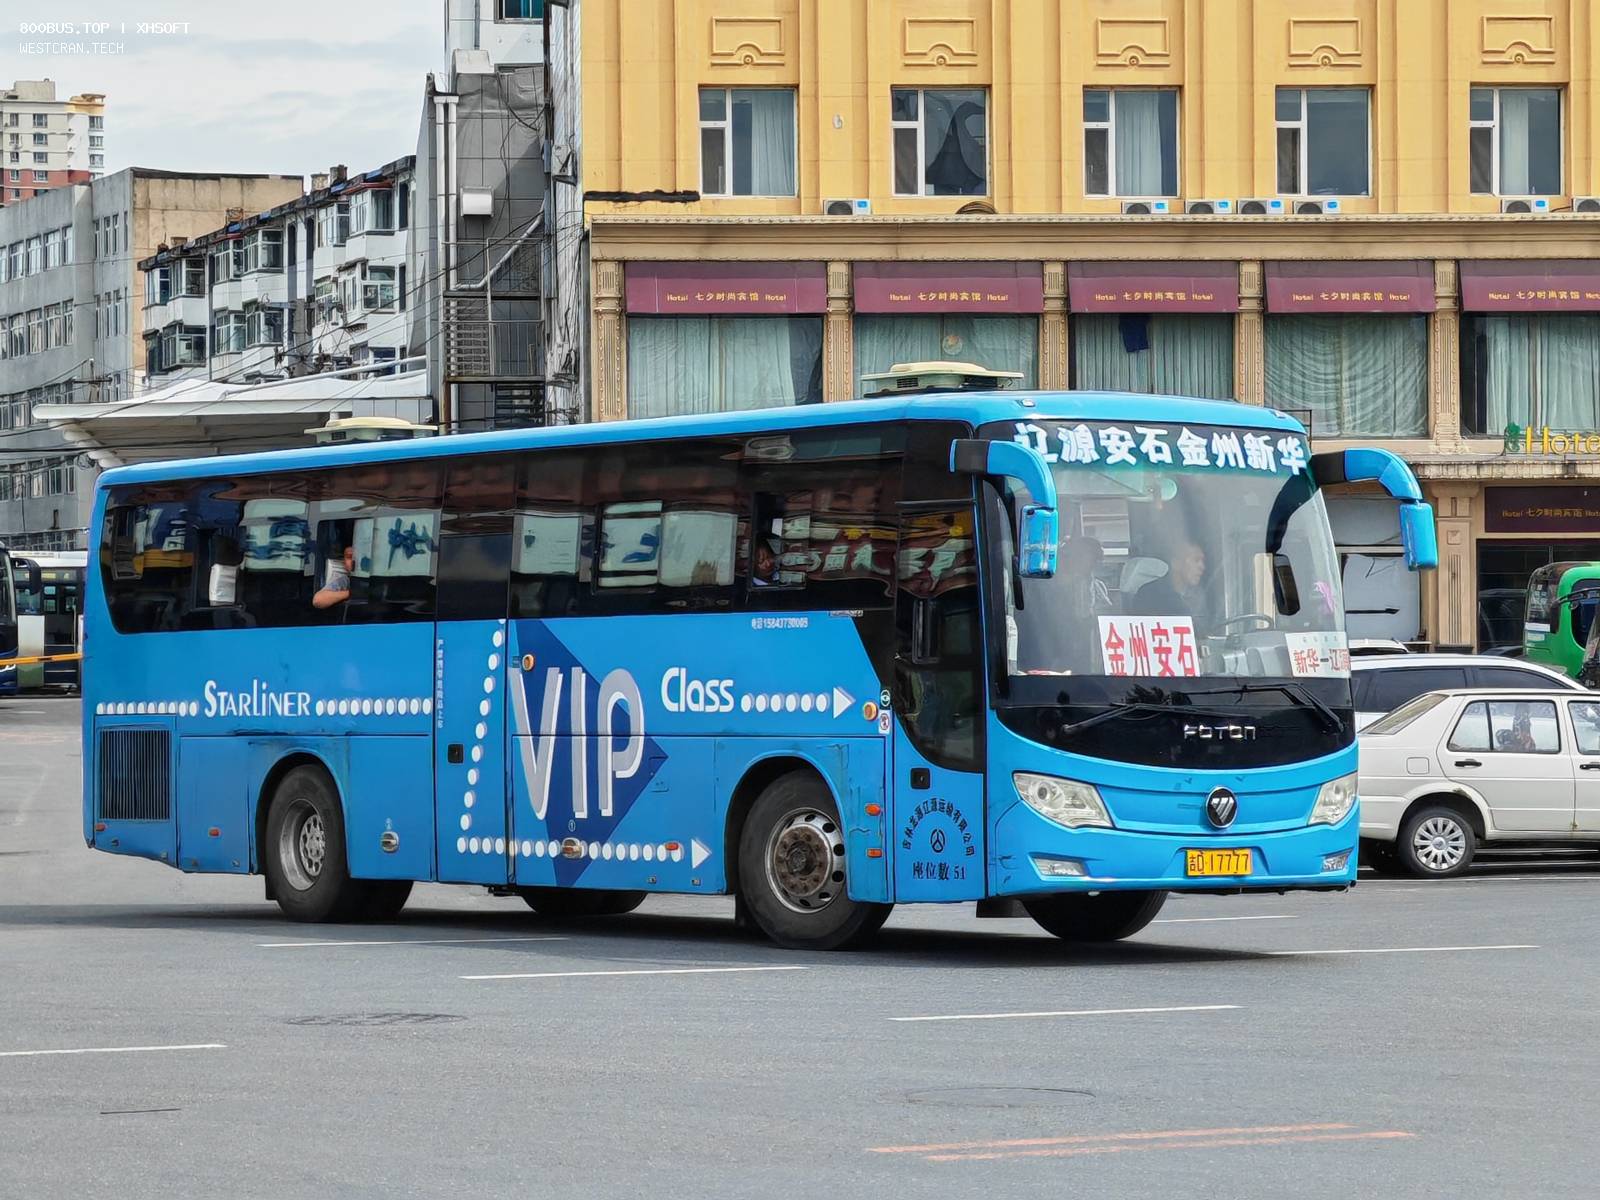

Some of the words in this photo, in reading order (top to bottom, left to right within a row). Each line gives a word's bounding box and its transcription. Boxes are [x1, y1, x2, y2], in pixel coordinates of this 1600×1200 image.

[1014, 423, 1307, 475] 辽源安石金州新华
[1105, 622, 1195, 677] 金州安石
[661, 667, 735, 712] Class
[508, 667, 645, 820] VIP
